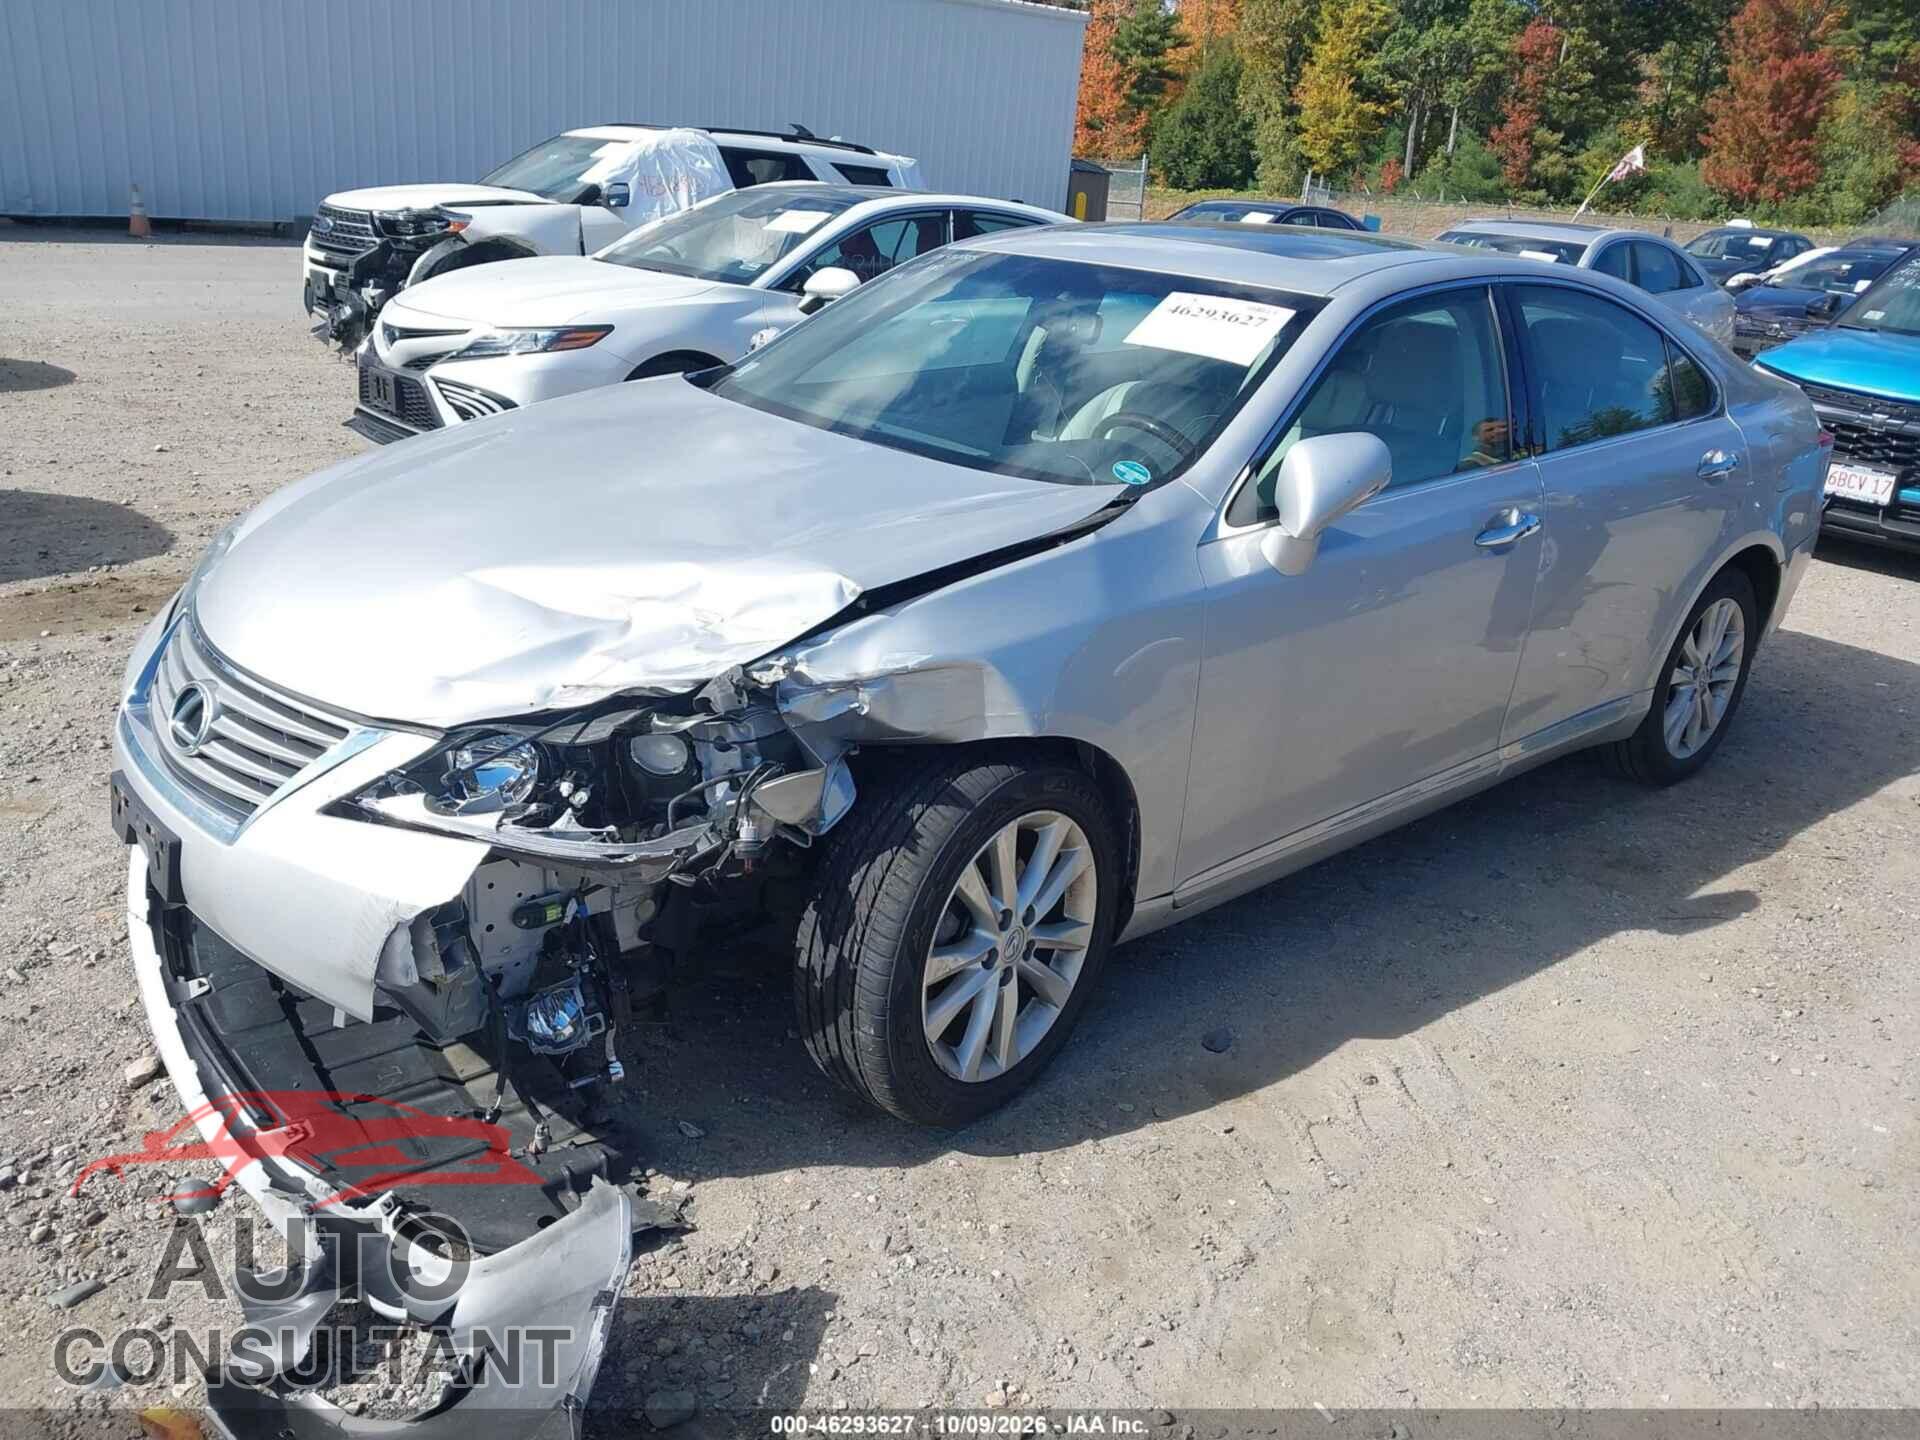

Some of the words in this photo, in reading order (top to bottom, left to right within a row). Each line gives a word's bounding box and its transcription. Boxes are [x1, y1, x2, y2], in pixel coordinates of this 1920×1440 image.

[1168, 304, 1268, 327] 46293627
[1828, 470, 1868, 490] 6BCV
[1872, 479, 1893, 496] 17
